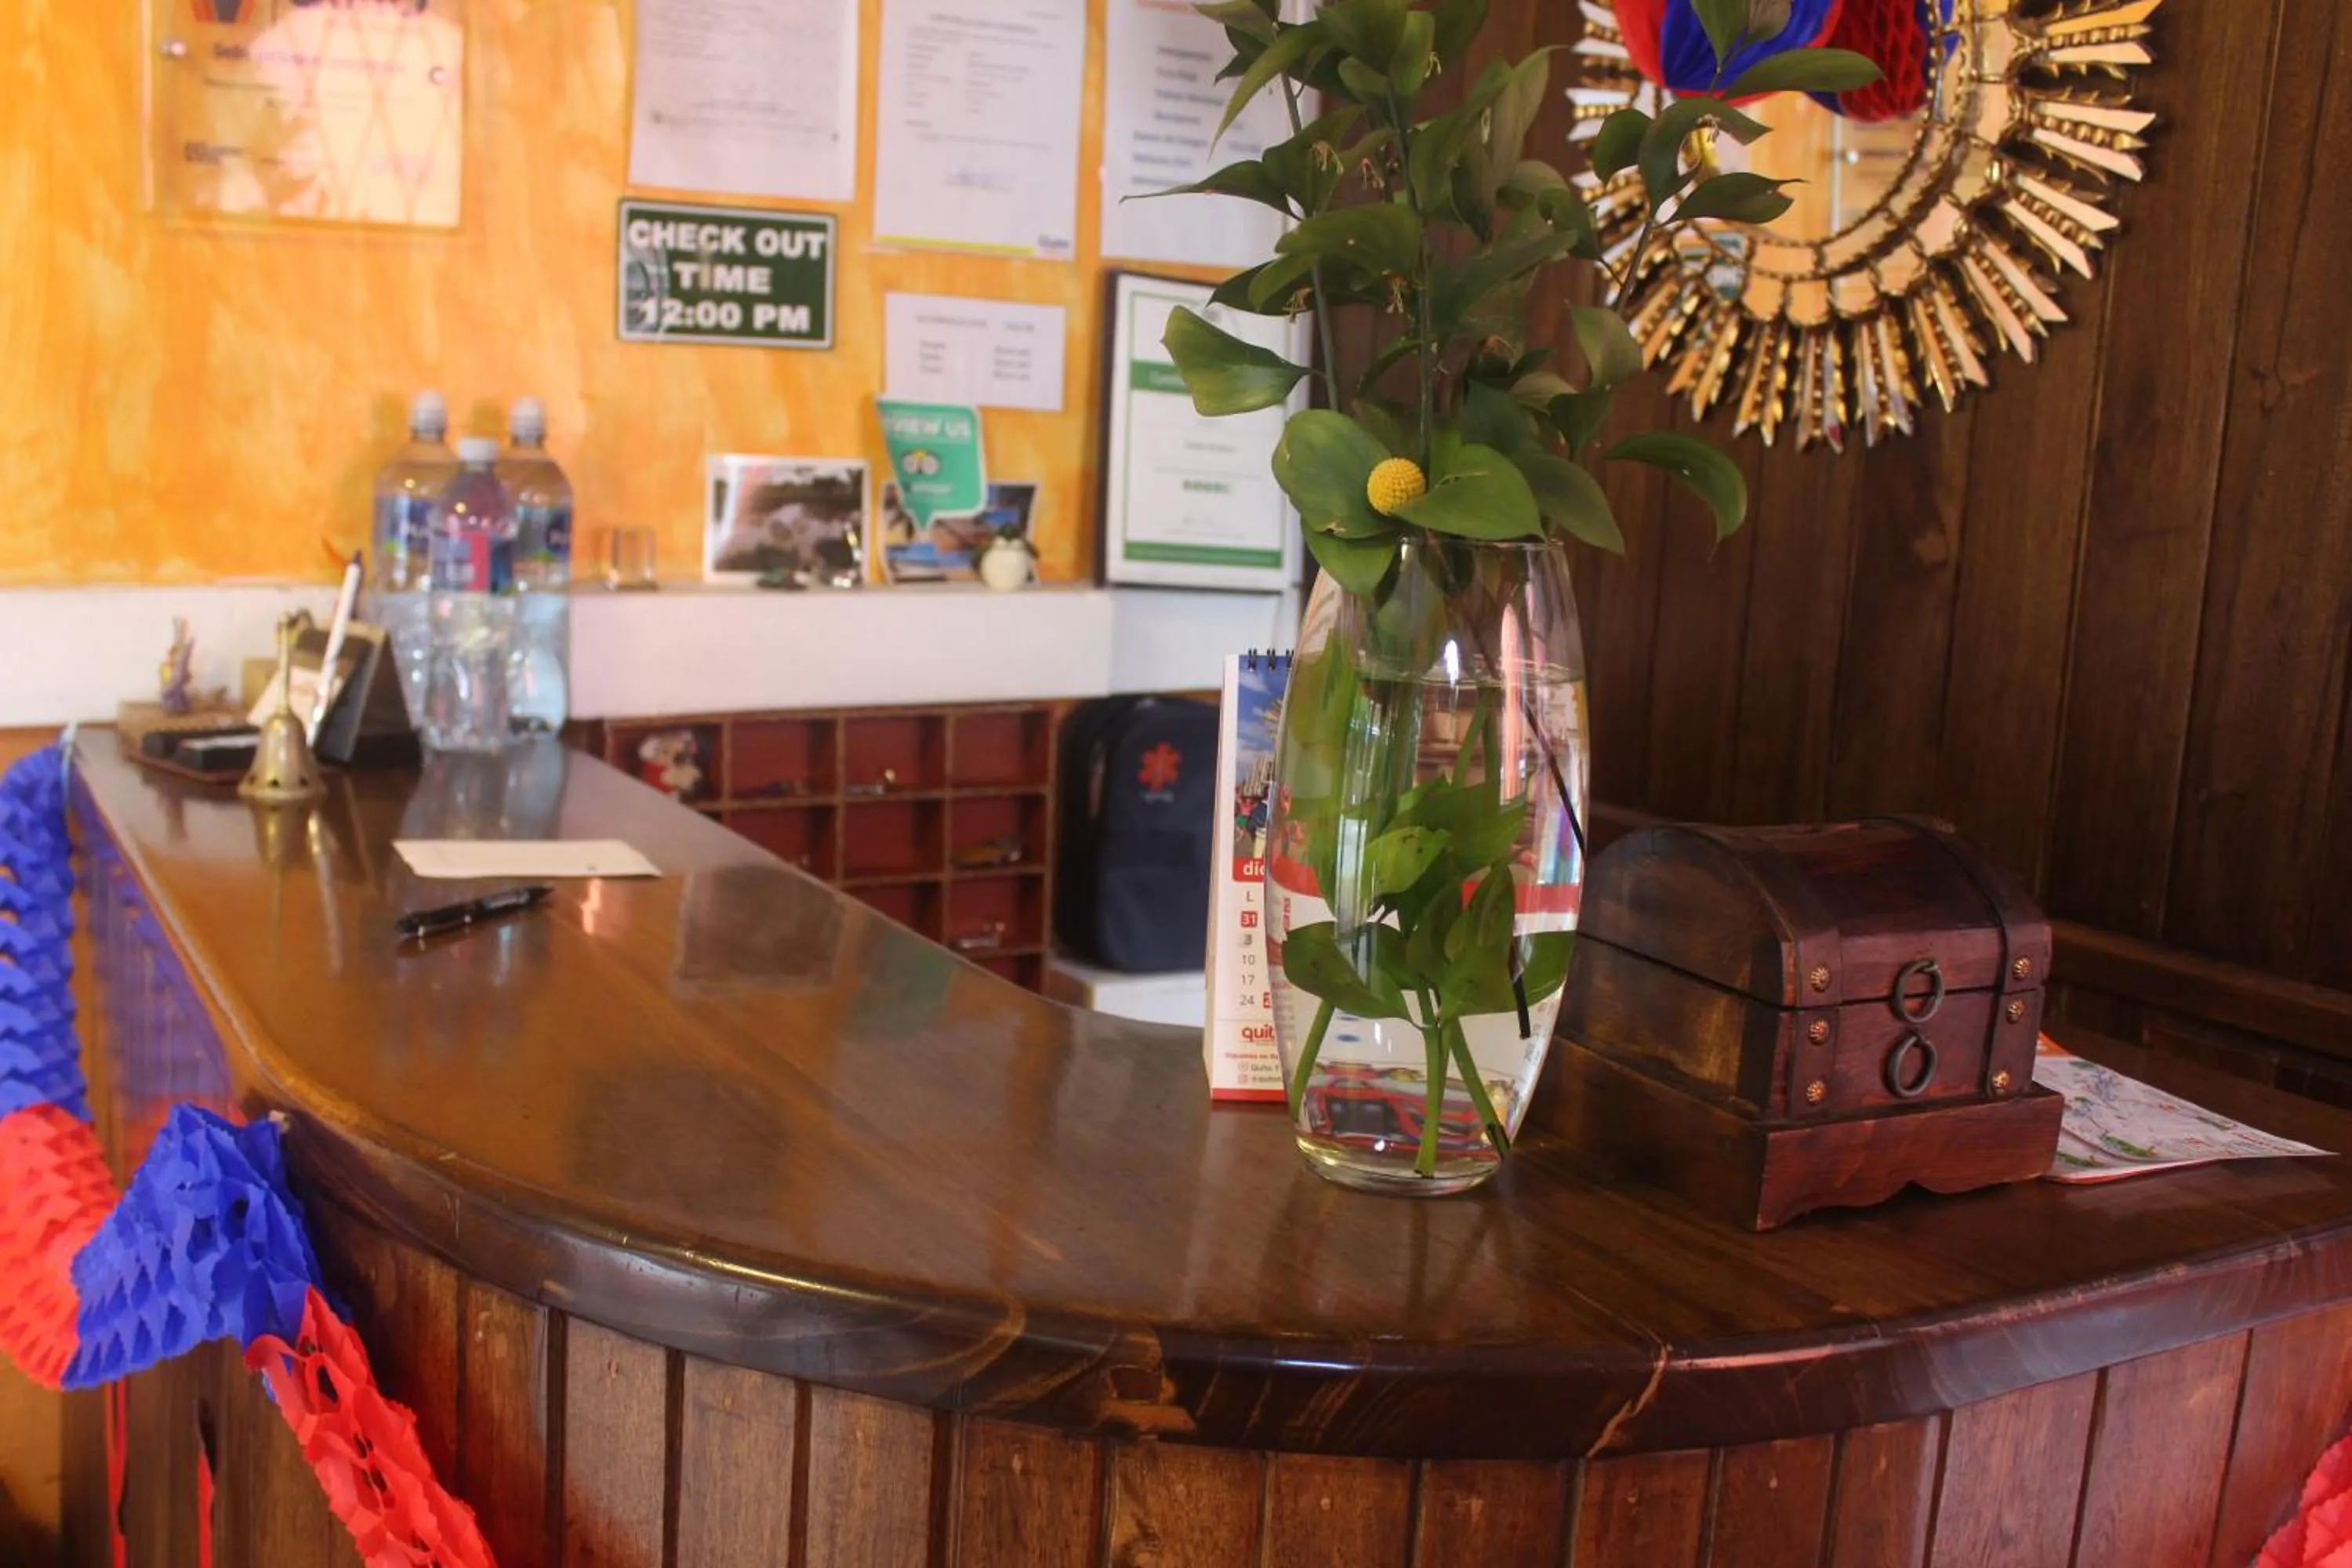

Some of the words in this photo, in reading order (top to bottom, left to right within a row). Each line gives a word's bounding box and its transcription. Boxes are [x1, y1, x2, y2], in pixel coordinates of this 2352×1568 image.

[628, 219, 746, 255] CHECK
[754, 227, 827, 260] OUT
[673, 260, 772, 295] TIME
[640, 297, 742, 330] 12:00
[752, 303, 811, 334] PM
[1247, 891, 1254, 902] L
[1243, 914, 1256, 925] 31
[1242, 954, 1255, 965] 10
[1242, 975, 1255, 985] 17
[1240, 995, 1254, 1006] 24
[1241, 1024, 1276, 1042] quit
